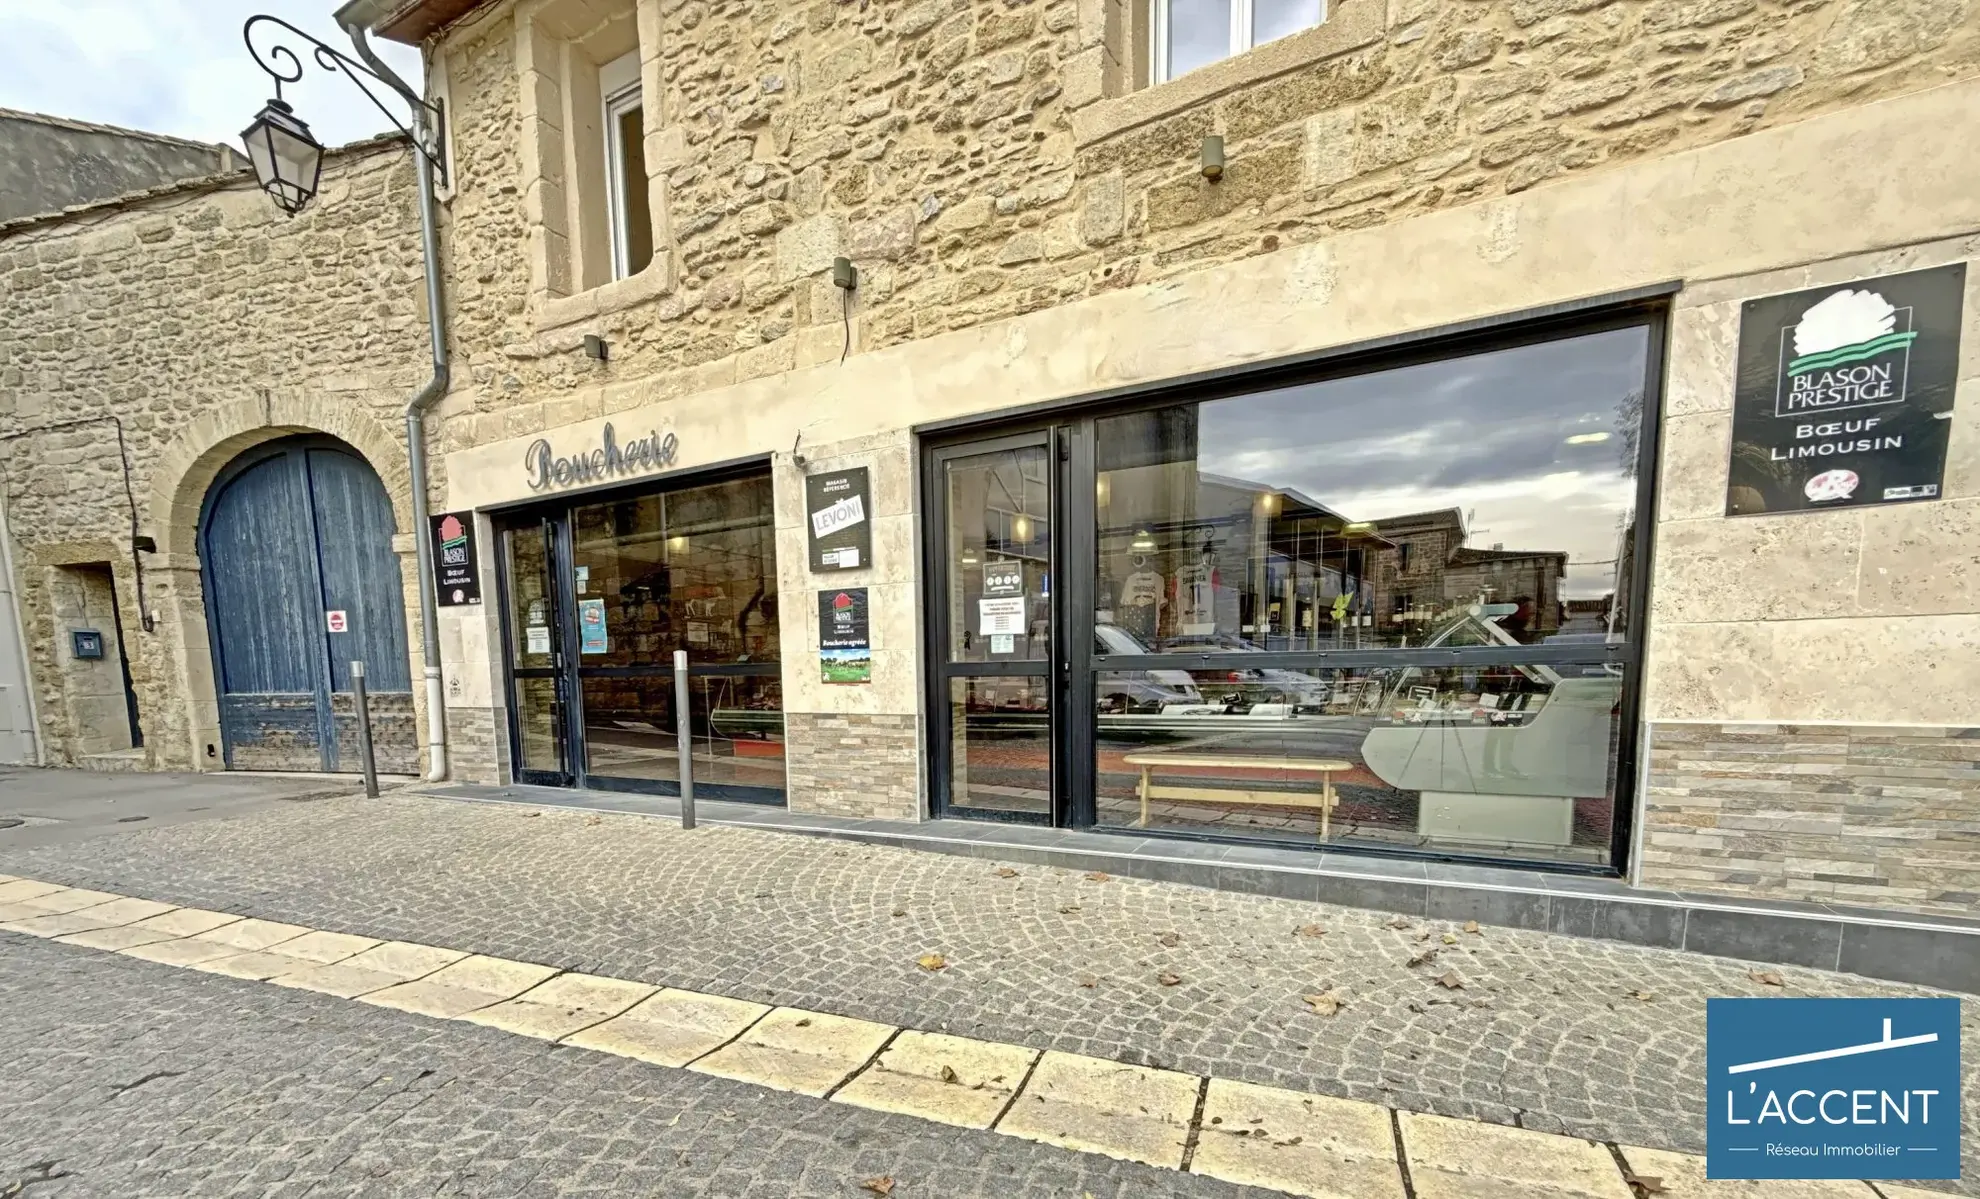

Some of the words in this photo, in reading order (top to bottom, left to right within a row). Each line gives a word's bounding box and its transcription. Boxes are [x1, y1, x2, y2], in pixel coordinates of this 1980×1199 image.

[1793, 363, 1891, 392] BLASON
[1788, 380, 1894, 410] PRESTIGE
[1796, 418, 1881, 439] BŒUF
[525, 422, 676, 489] Boucherie
[1771, 435, 1902, 461] LIMOUSIN
[815, 499, 861, 531] LEVONI
